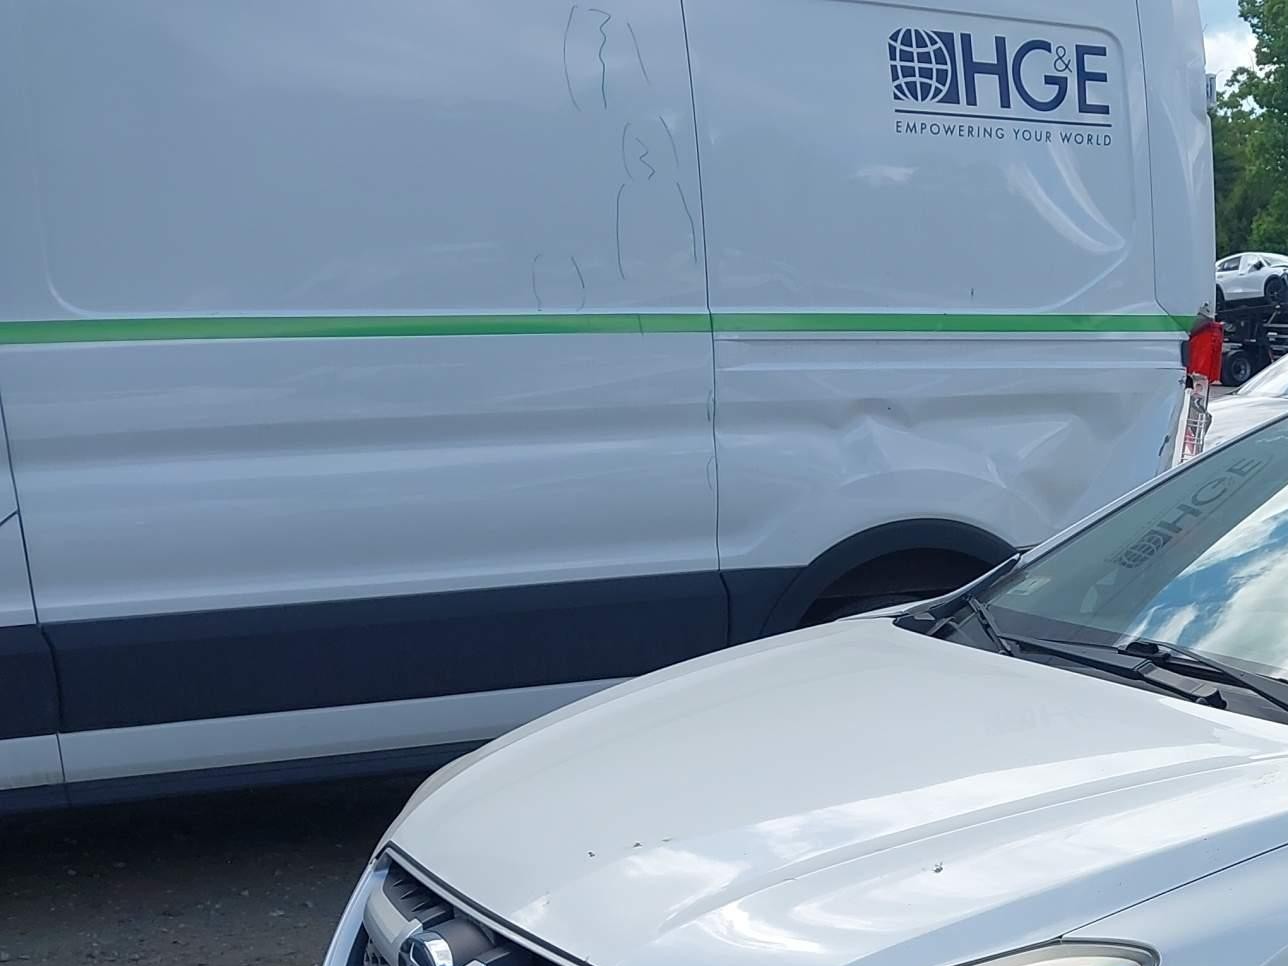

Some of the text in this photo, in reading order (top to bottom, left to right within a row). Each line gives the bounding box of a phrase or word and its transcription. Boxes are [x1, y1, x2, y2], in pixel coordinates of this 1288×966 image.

[959, 32, 1110, 115] HG&E
[895, 120, 1112, 146] EMPOWERING YOUR WORLD
